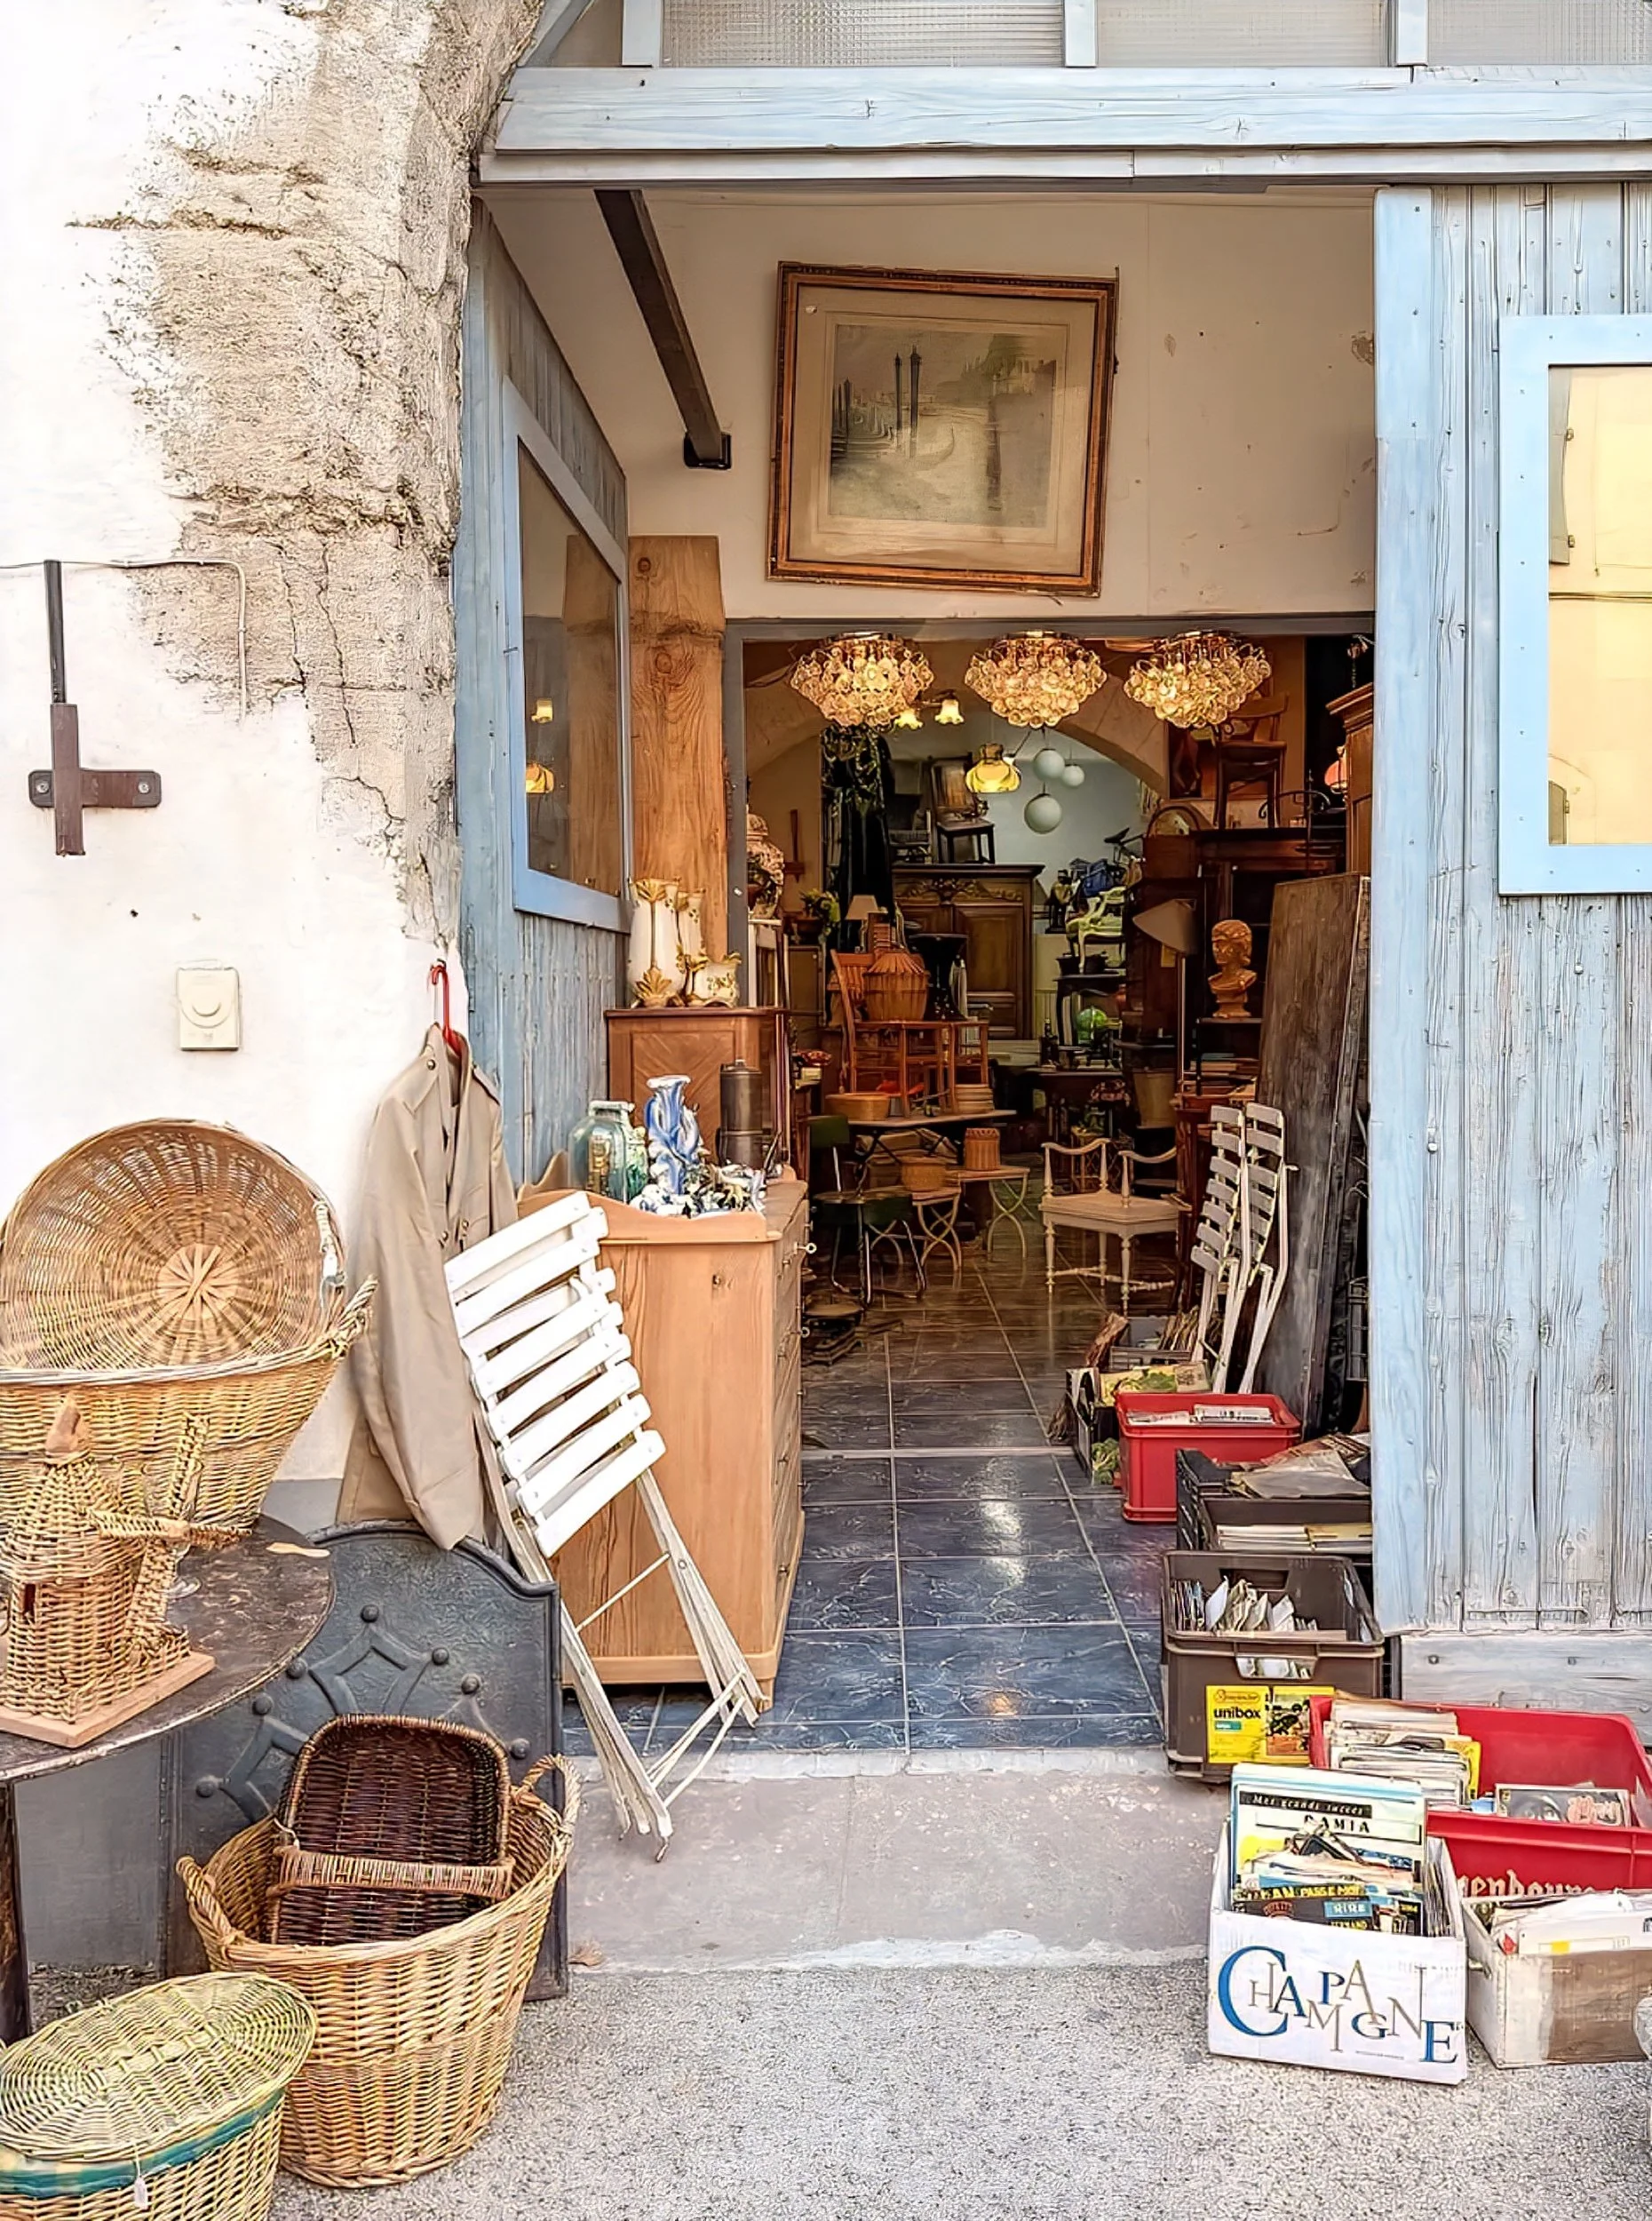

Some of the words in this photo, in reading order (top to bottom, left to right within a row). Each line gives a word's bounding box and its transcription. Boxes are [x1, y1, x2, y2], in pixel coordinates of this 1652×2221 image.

[1213, 1707, 1261, 1719] unibox
[1252, 1794, 1275, 1805] Mes
[1281, 1799, 1319, 1811] grands
[1218, 1946, 1457, 2064] CHAMPAGNE
